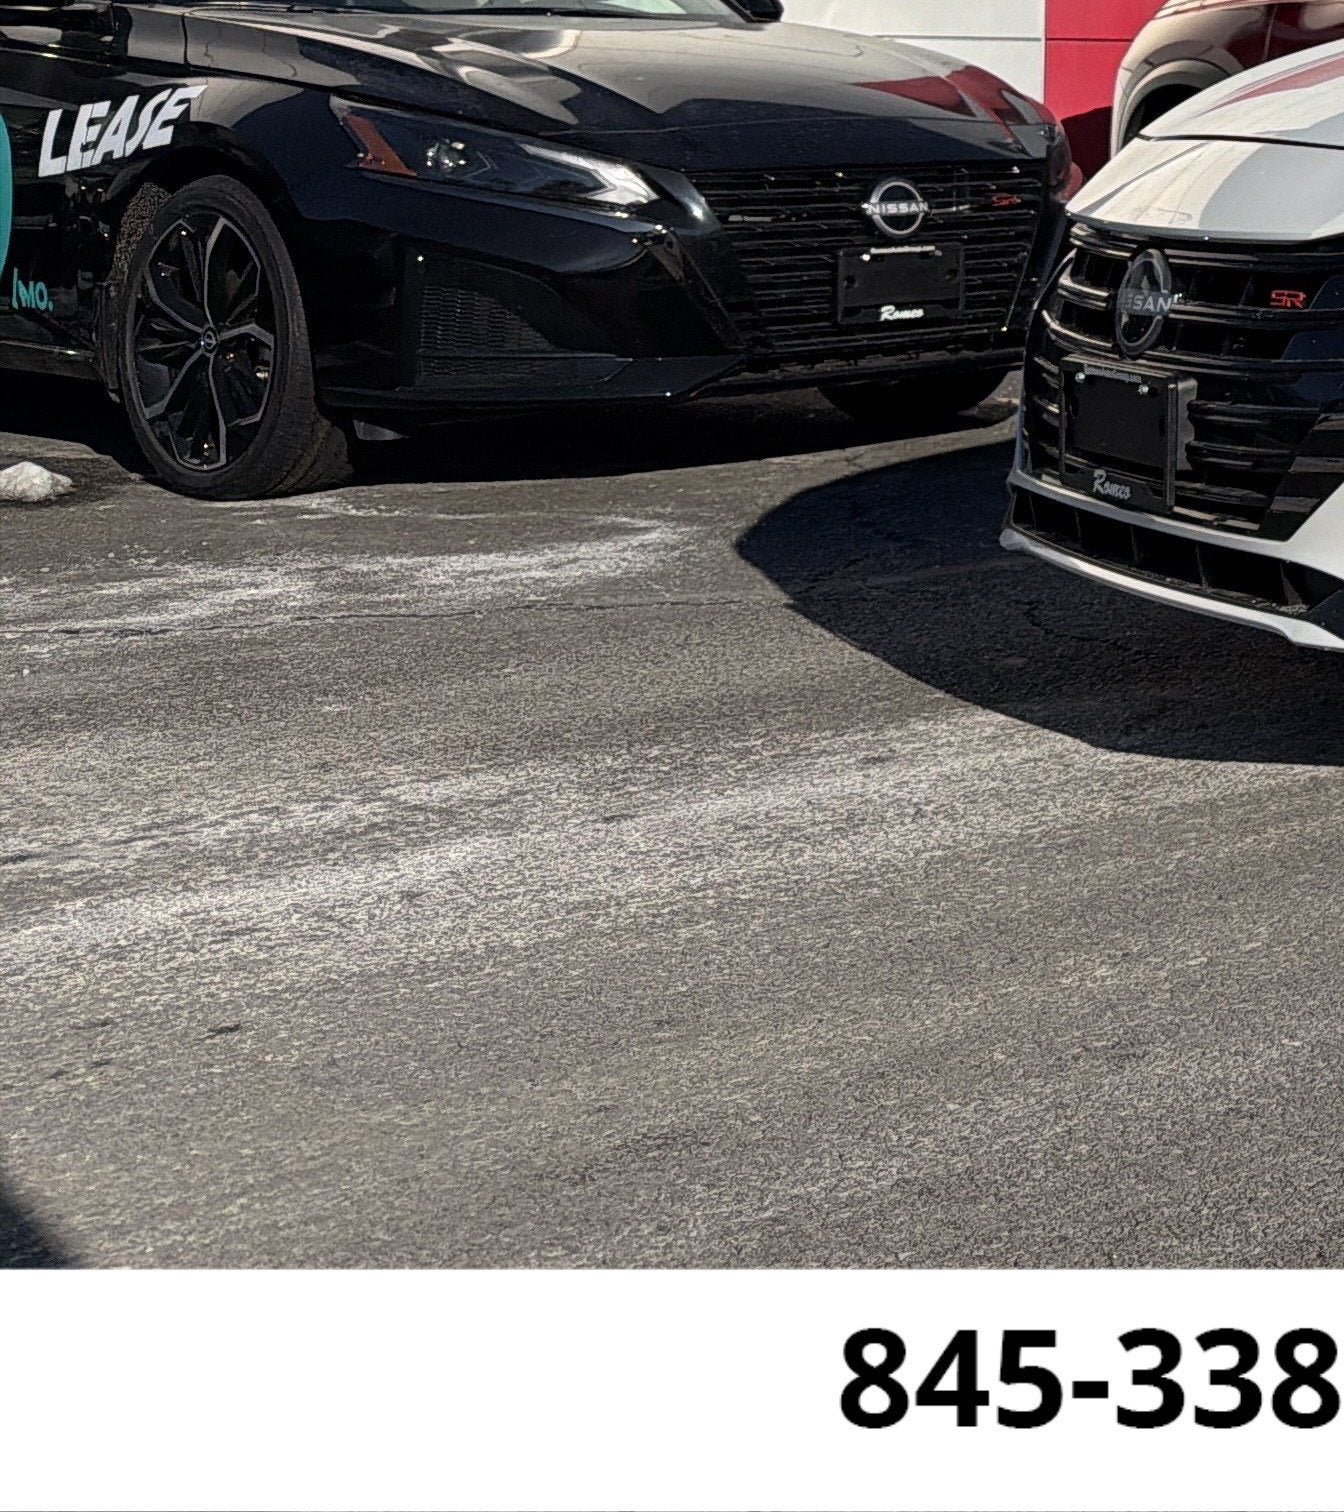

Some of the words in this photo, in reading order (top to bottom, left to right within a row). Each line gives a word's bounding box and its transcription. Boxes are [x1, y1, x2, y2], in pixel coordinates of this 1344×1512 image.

[38, 85, 208, 178] LEASE
[867, 202, 929, 214] NISSAN
[1270, 289, 1306, 308] SR
